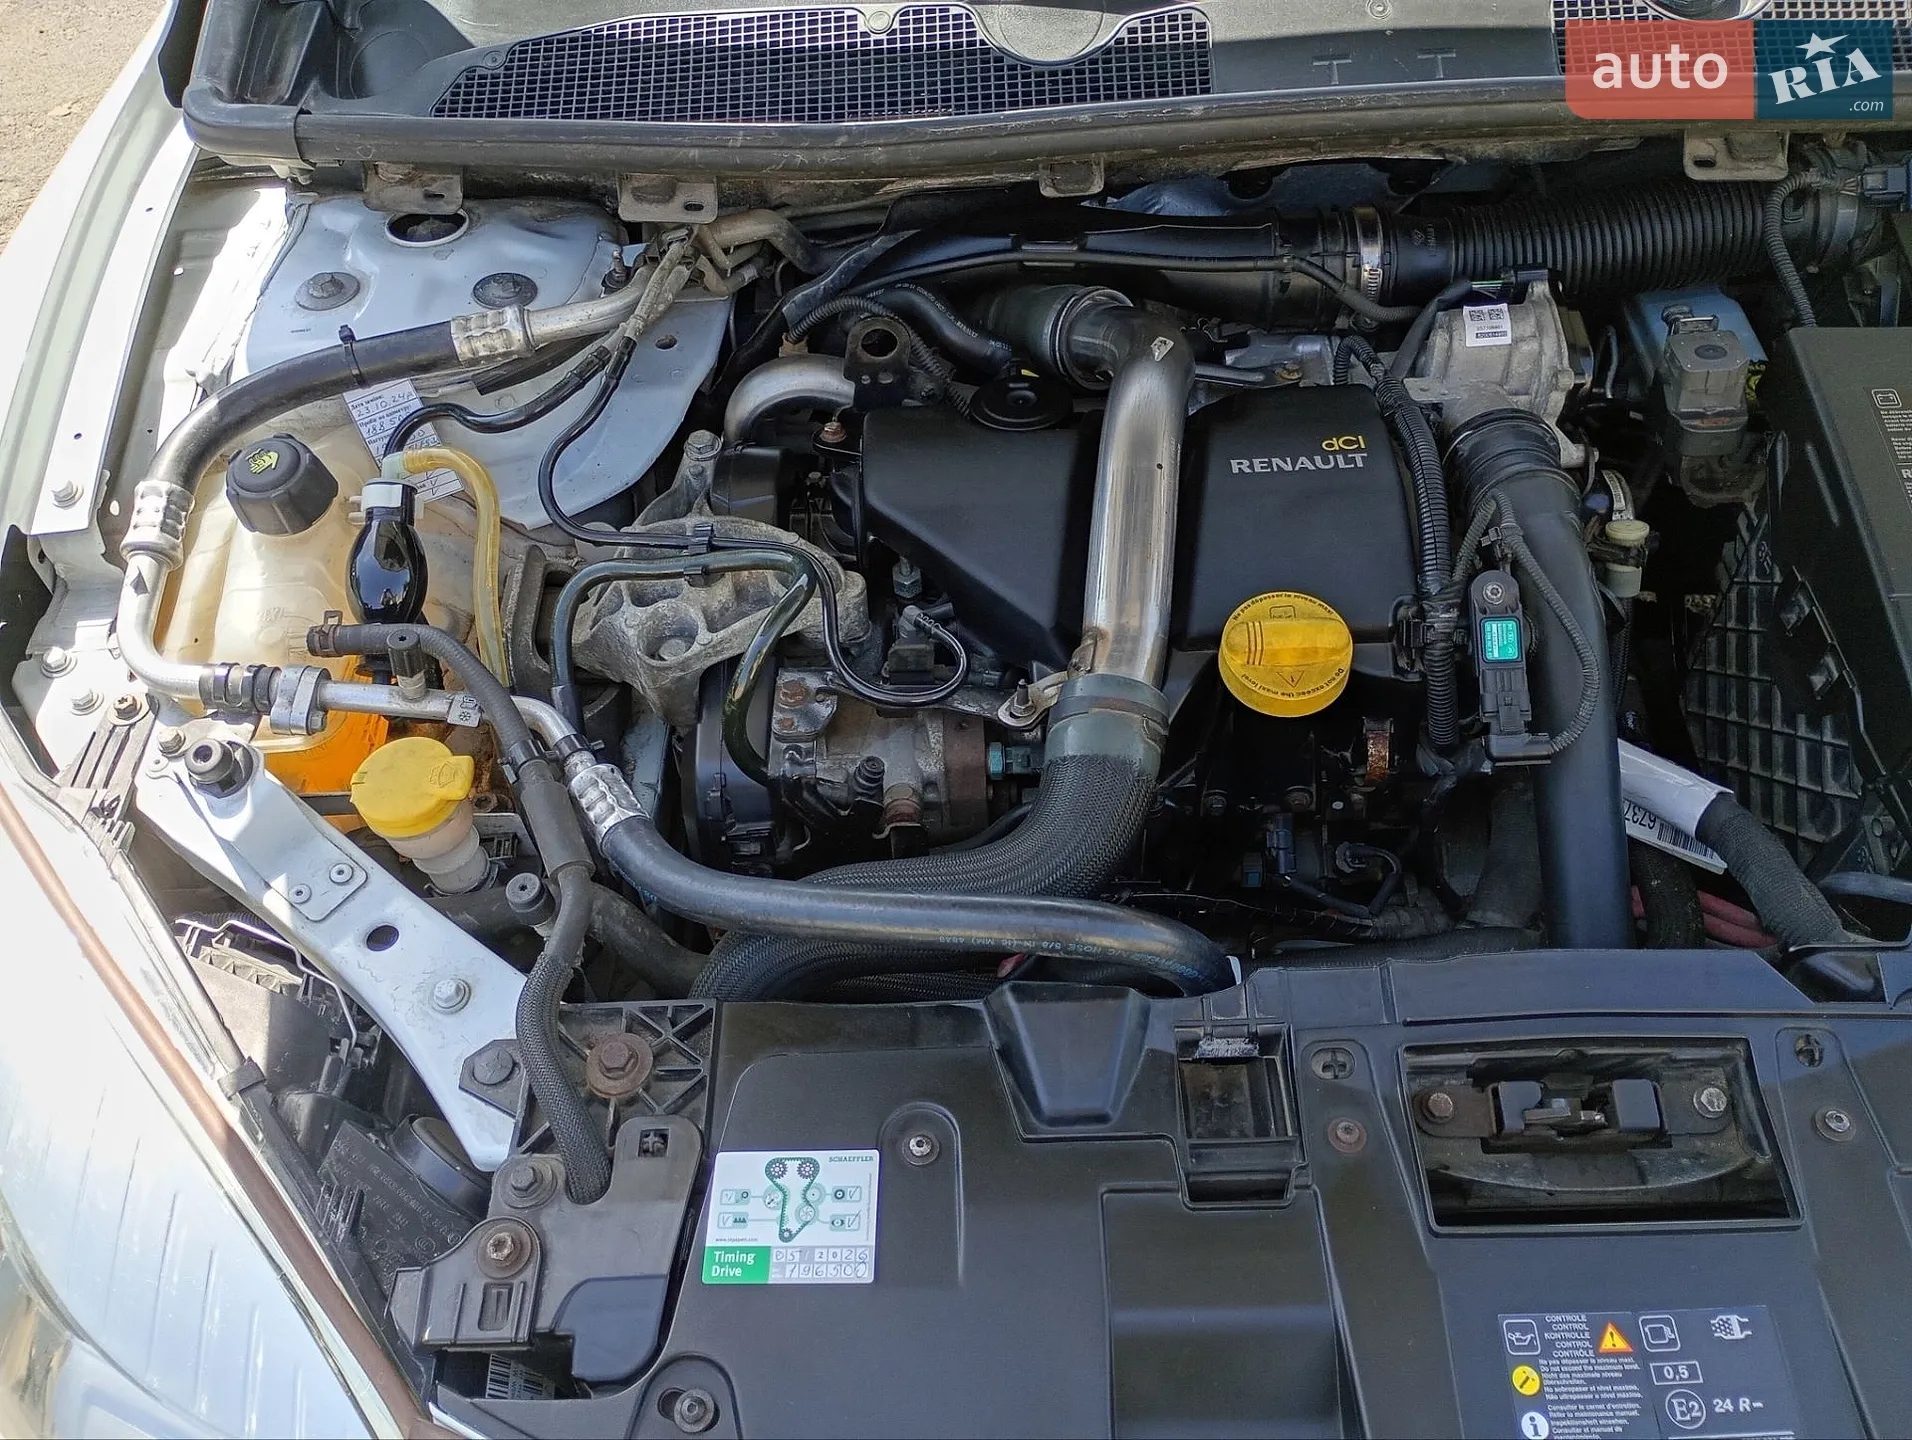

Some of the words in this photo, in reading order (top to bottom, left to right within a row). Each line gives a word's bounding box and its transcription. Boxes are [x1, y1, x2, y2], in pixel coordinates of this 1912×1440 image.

[1230, 453, 1367, 474] RENAULT
[829, 1155, 874, 1163] SCHAEFFLER
[714, 1250, 756, 1265] Timing
[711, 1265, 742, 1277] Drive
[1552, 1323, 1589, 1331] CONTROL
[1544, 1332, 1591, 1340] KONTROLLE
[1664, 1365, 1689, 1381] 0,5
[1671, 1399, 1701, 1421] E2
[1713, 1399, 1734, 1413] 24
